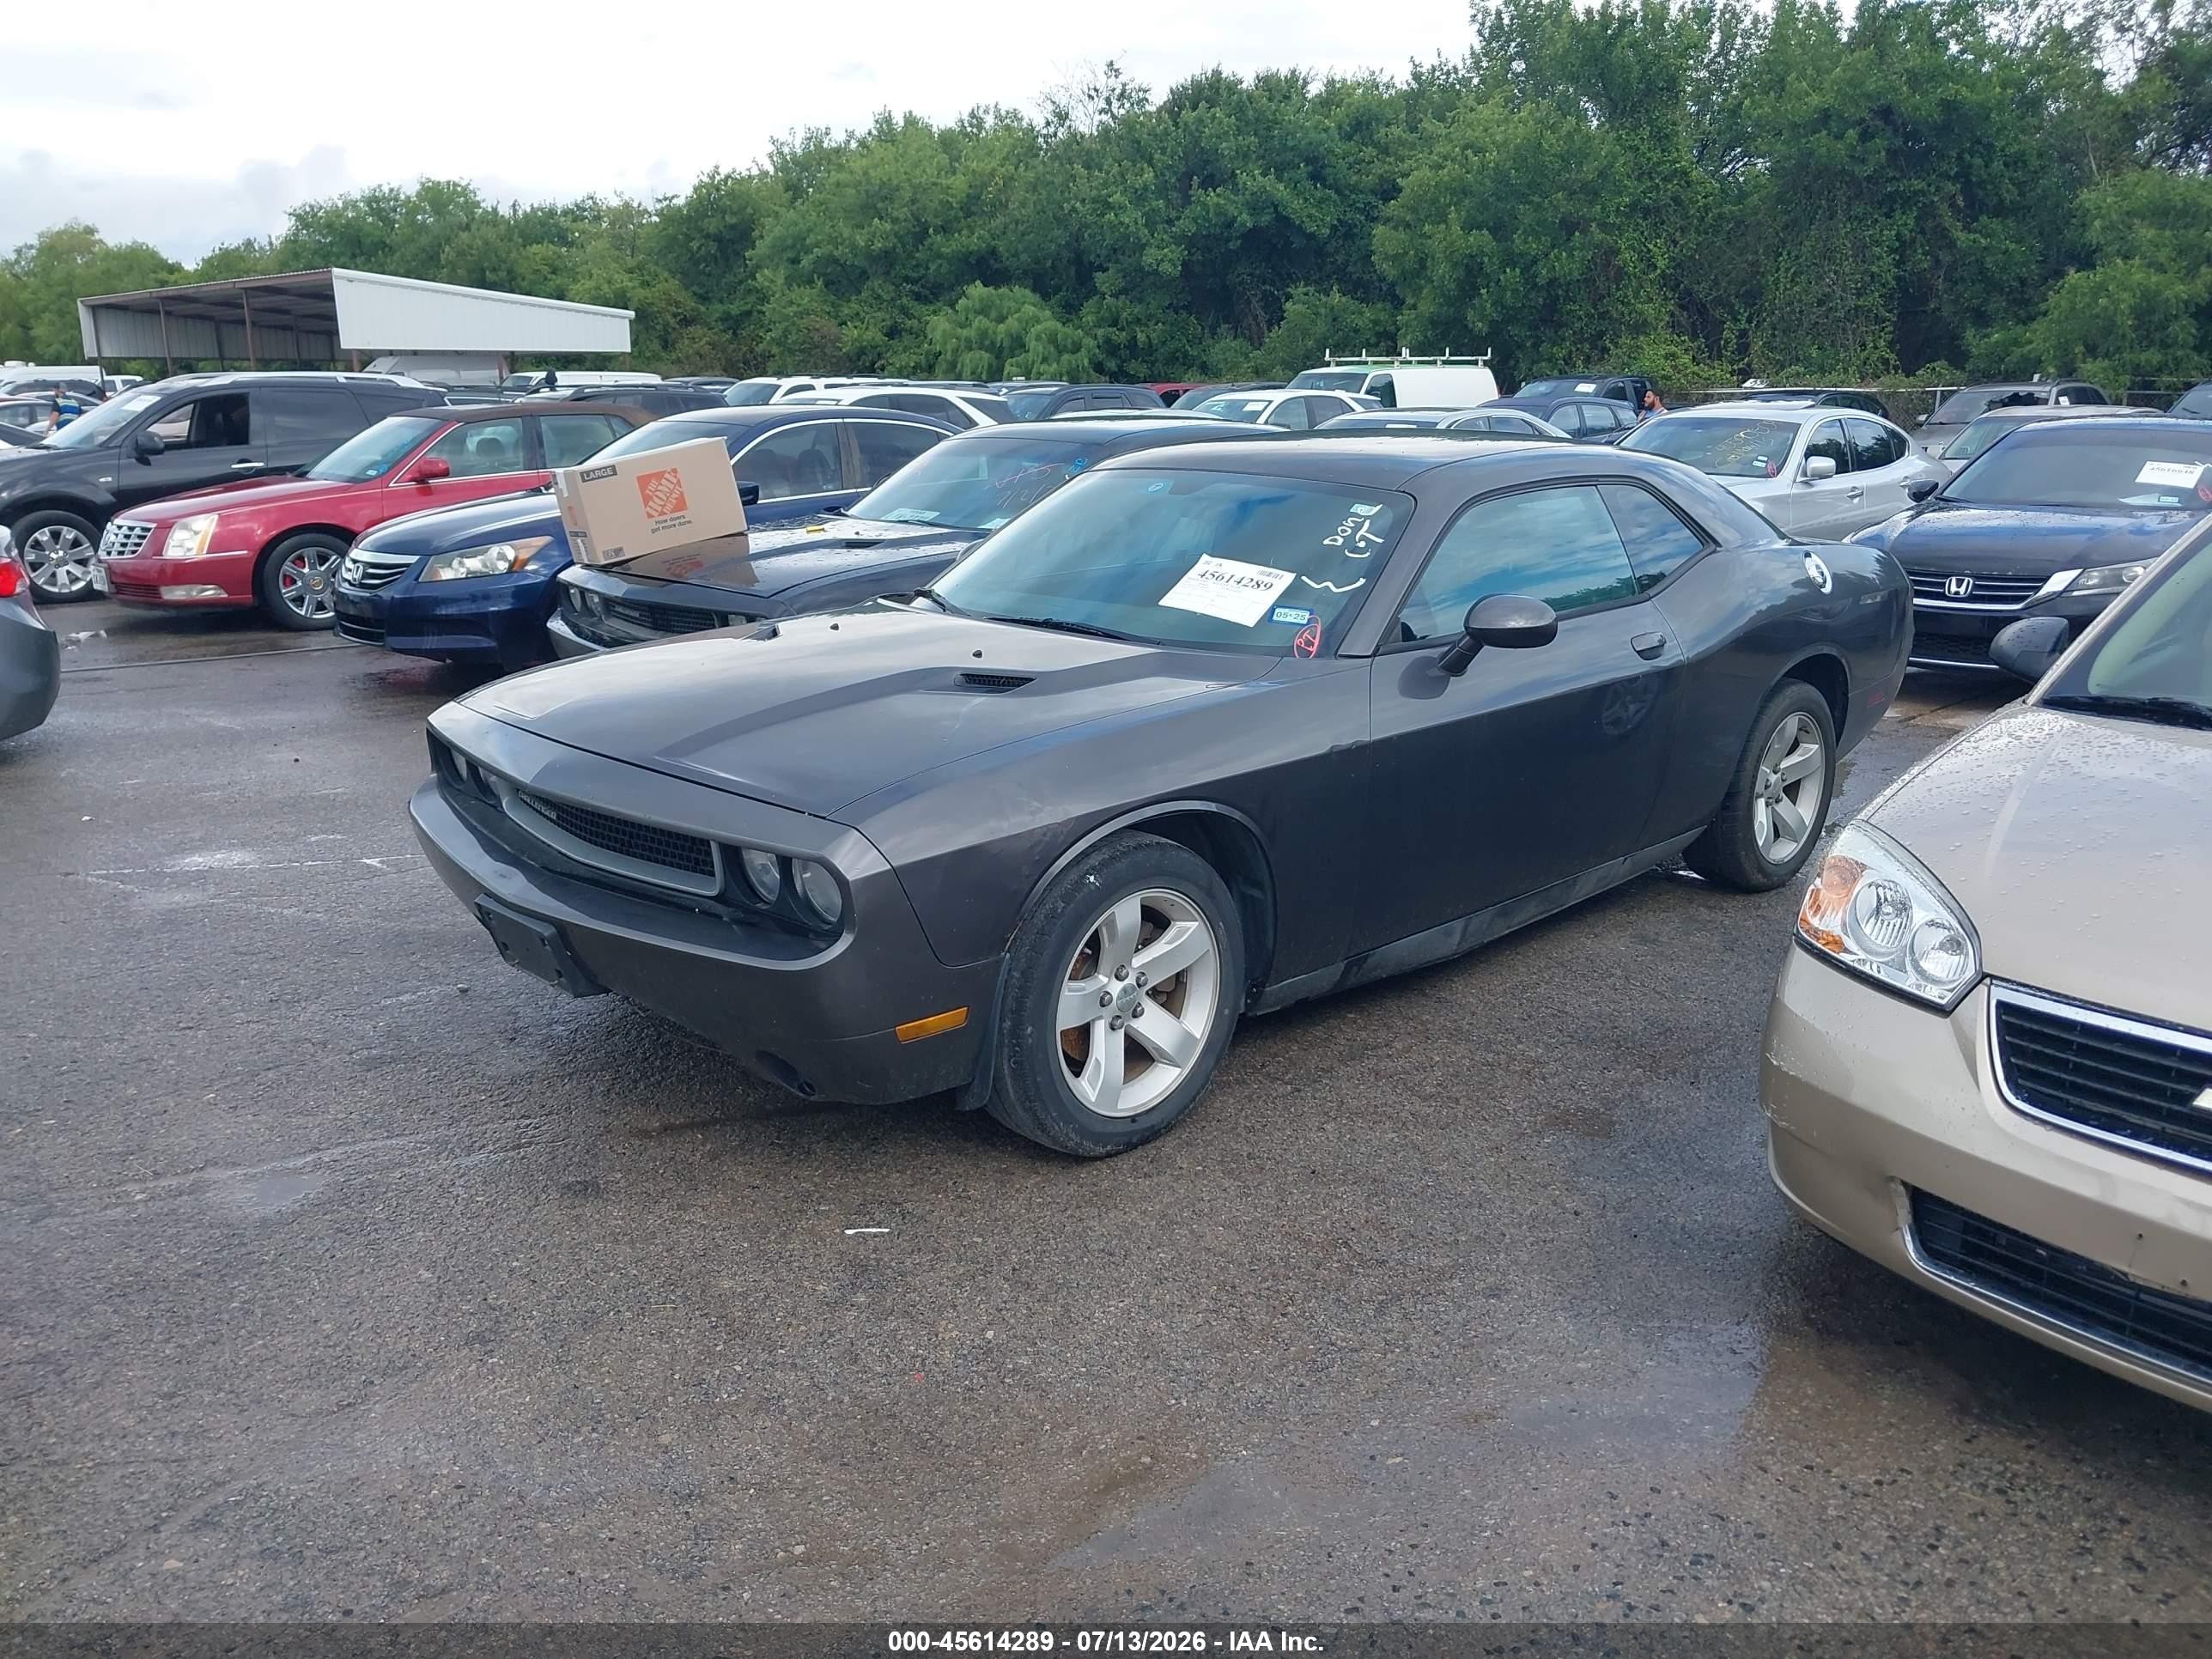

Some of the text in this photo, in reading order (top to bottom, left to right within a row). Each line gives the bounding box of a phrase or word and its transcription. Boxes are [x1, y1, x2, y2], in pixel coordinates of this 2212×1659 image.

[584, 467, 614, 480] LARGE
[646, 470, 678, 517] HOME
[1198, 568, 1274, 592] 45614289
